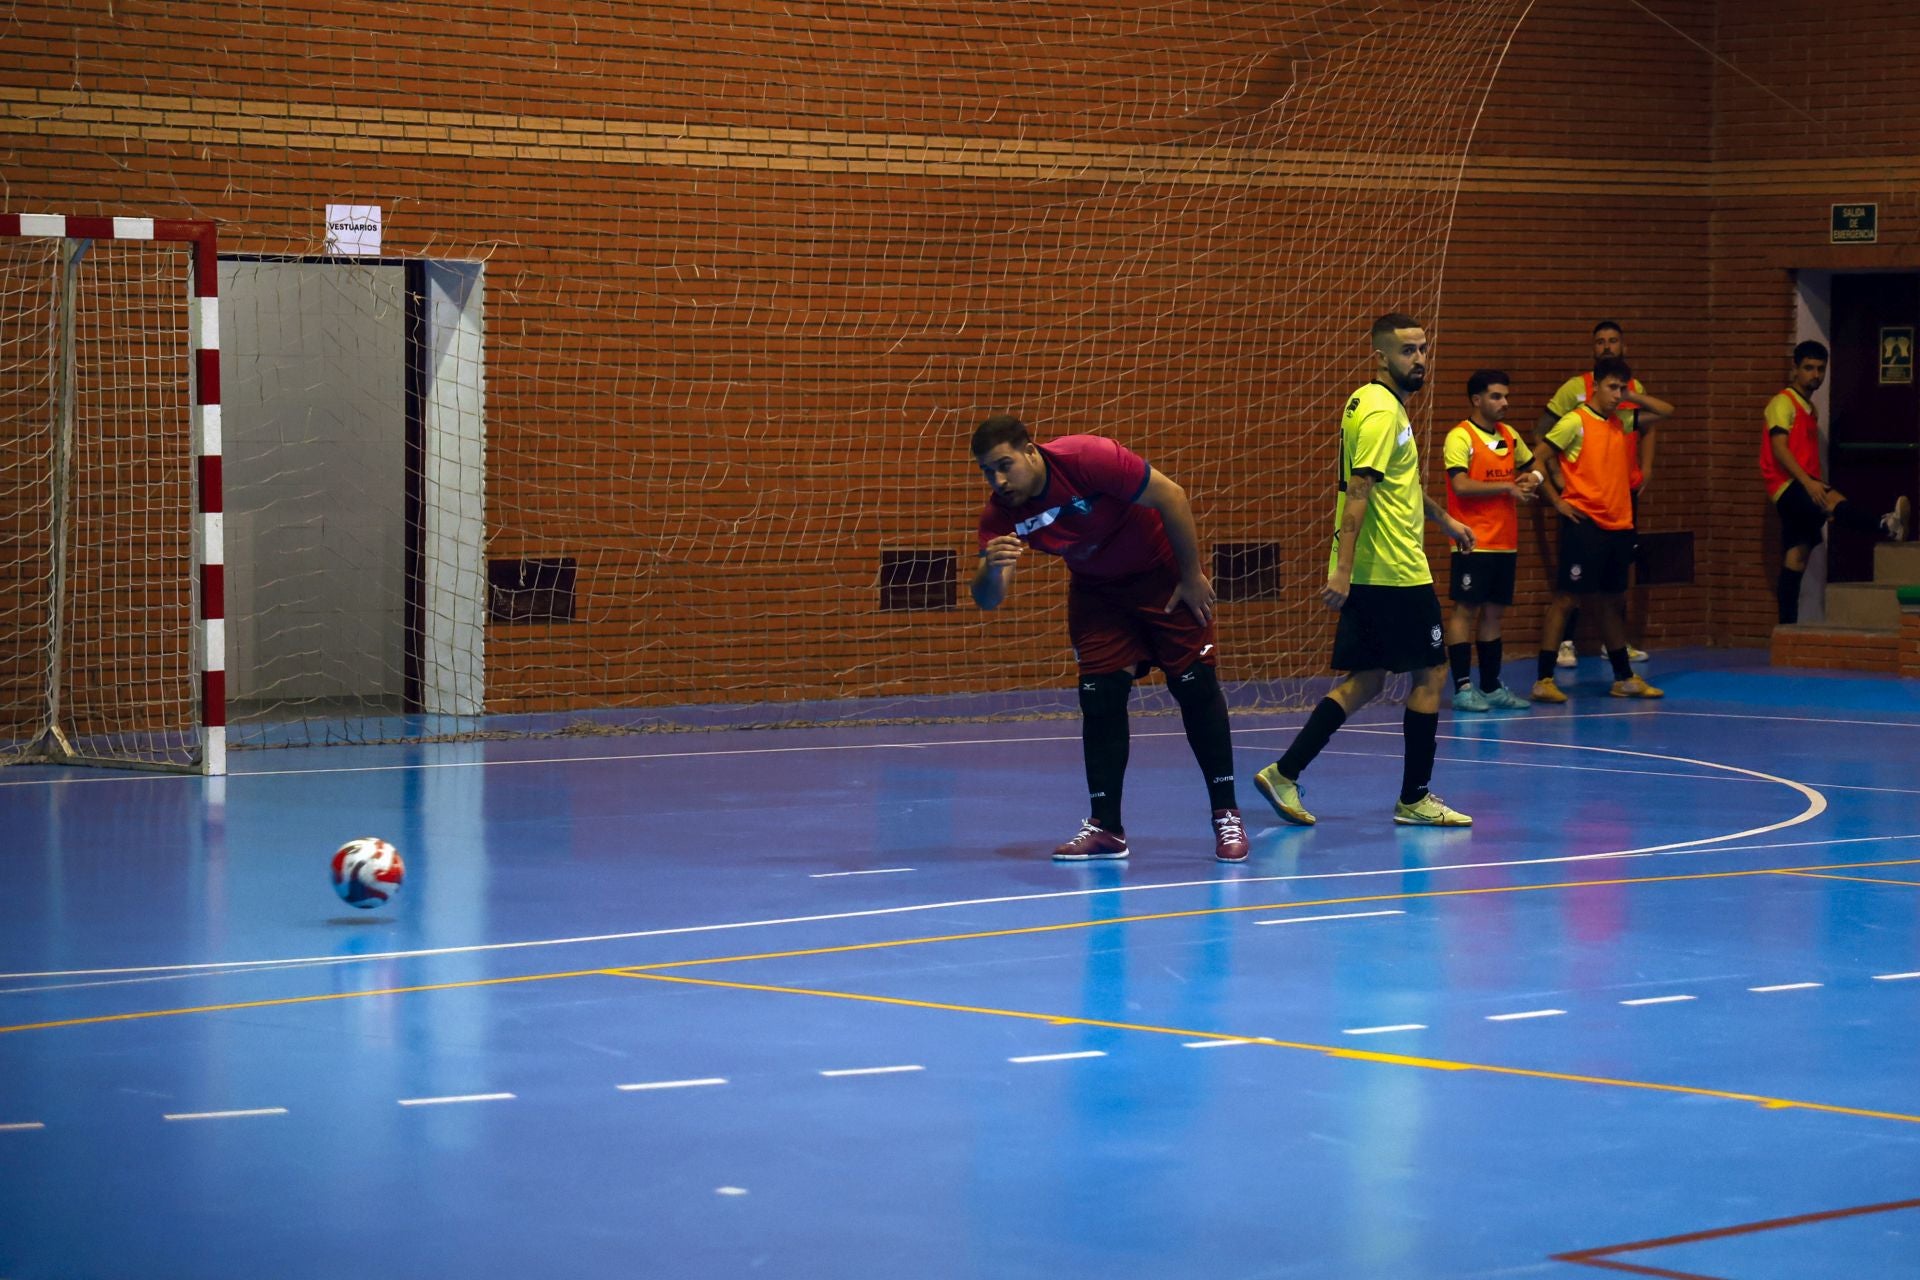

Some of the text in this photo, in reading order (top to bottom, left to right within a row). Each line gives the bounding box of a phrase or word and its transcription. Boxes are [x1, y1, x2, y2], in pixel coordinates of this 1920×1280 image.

[1842, 207, 1866, 217] SALIDA
[329, 223, 378, 232] VESTUARIOS
[1849, 218, 1858, 228] DE
[1833, 229, 1875, 239] EMERGENCIA
